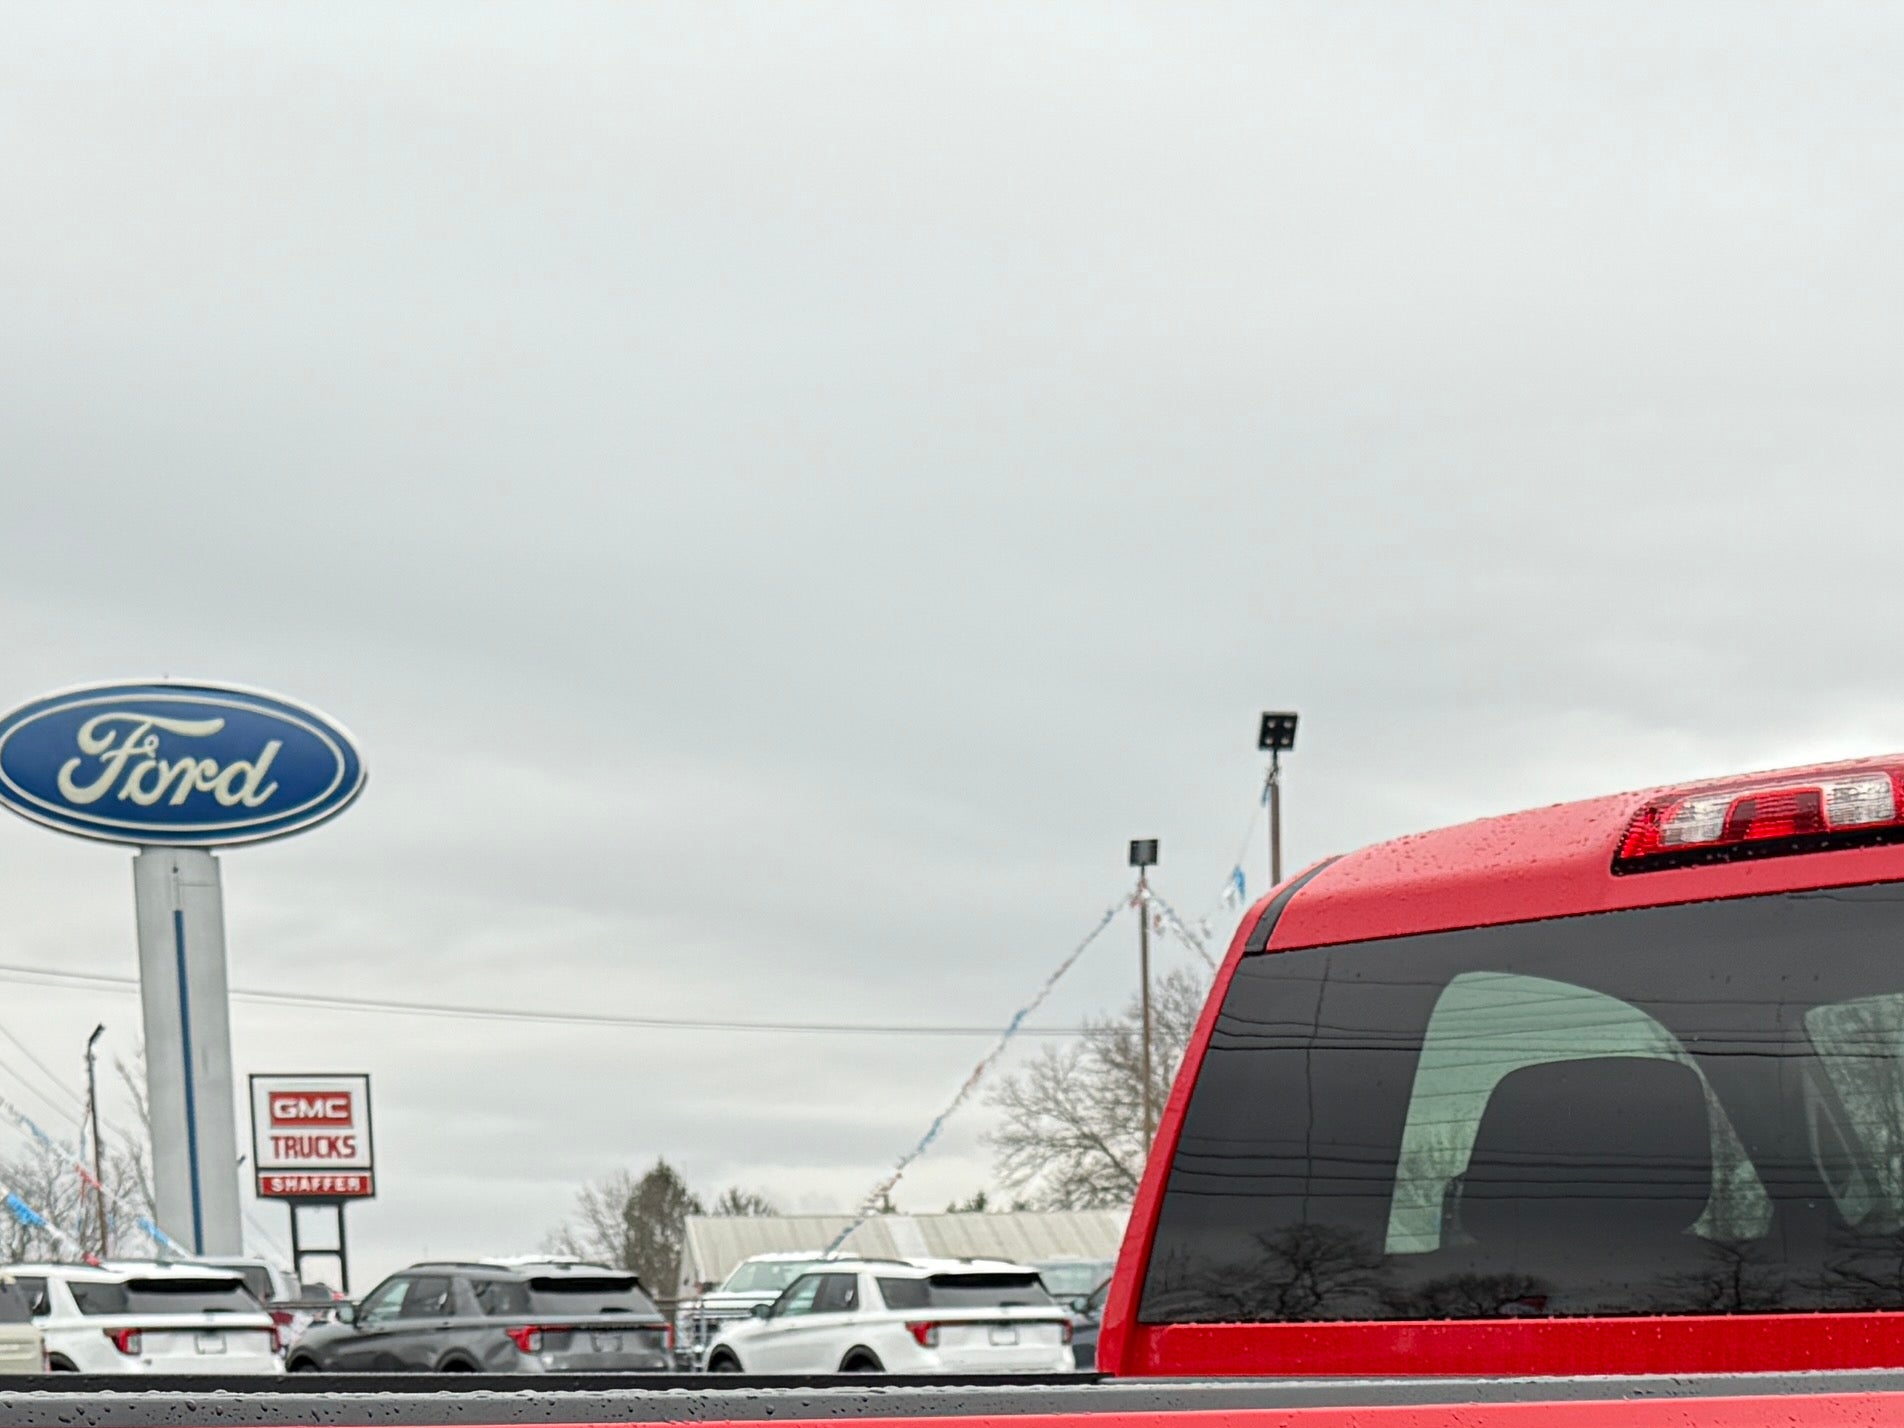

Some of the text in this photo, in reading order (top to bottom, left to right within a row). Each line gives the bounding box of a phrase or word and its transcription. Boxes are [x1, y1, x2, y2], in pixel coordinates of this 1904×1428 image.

[57, 711, 283, 807] Ford
[273, 1098, 349, 1119] GMC
[270, 1135, 357, 1159] TRUCKS
[271, 1177, 361, 1192] SHAFFER
